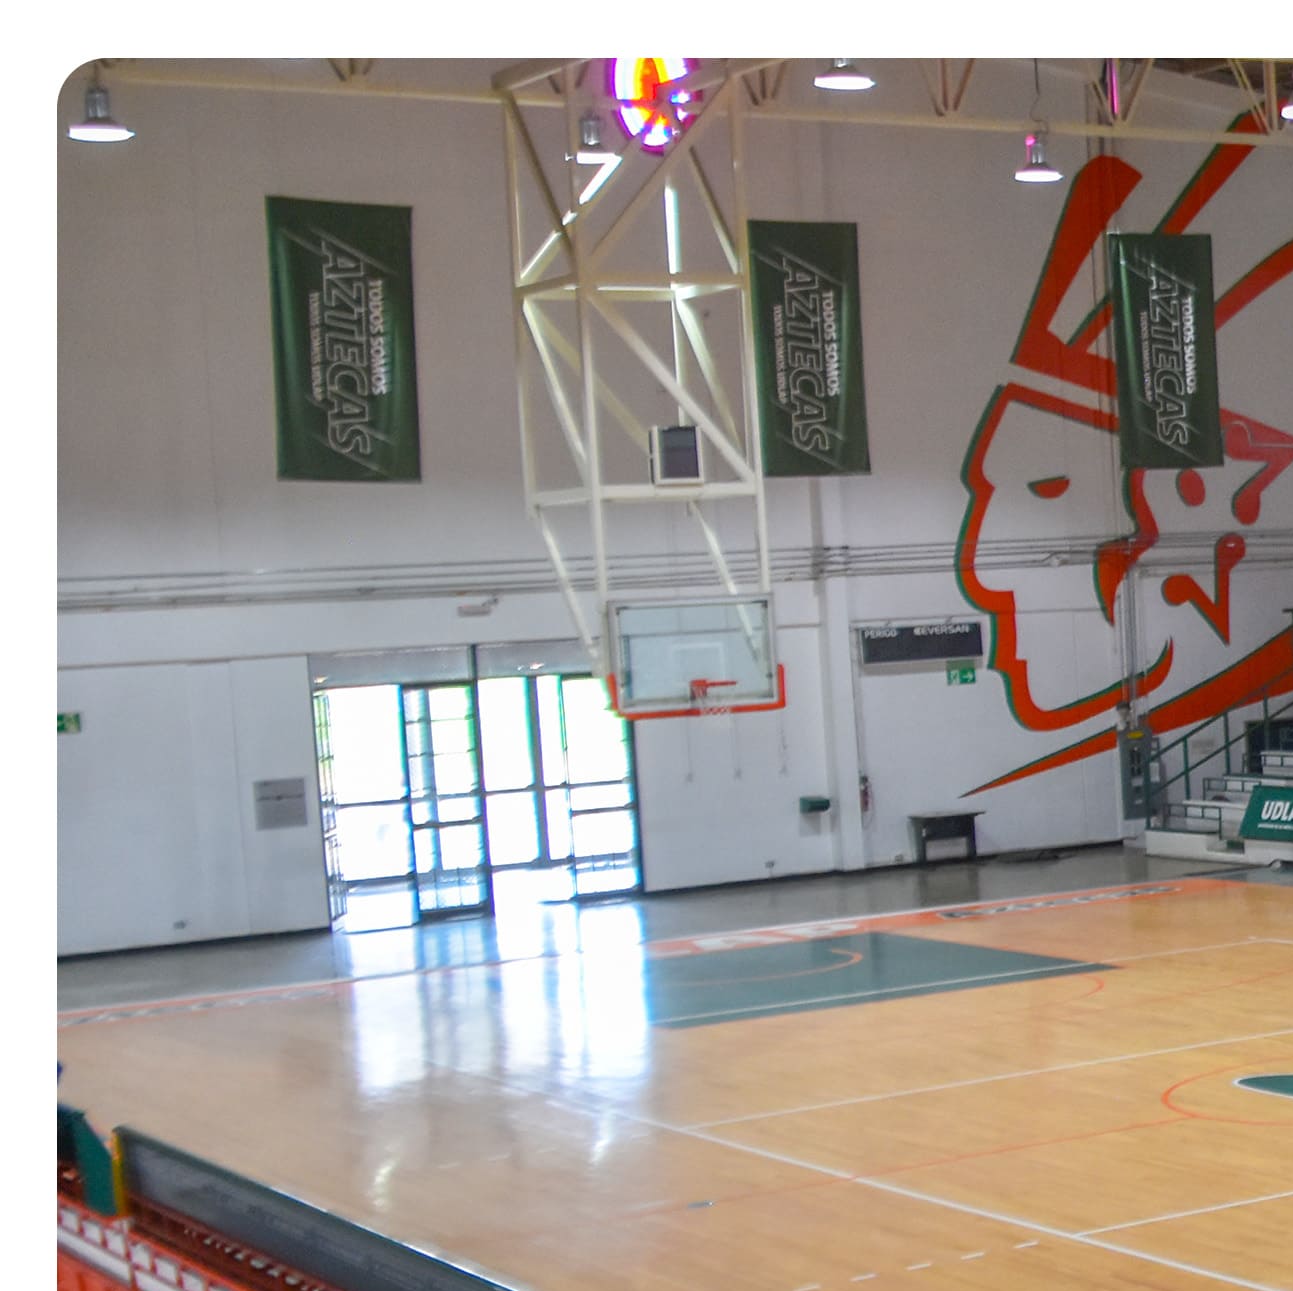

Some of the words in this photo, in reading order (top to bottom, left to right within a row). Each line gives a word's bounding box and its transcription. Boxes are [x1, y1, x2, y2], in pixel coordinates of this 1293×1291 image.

[368, 279, 386, 334] TODOS
[822, 290, 837, 343] TODOS
[1182, 296, 1195, 344] TODOS
[321, 240, 371, 455] AZTECAS
[370, 336, 387, 395] SOMOS
[782, 256, 830, 452] AZTECAS
[825, 344, 841, 397] SOMOS
[1150, 270, 1189, 445] AZTECAS
[1184, 345, 1196, 394] SOMOS
